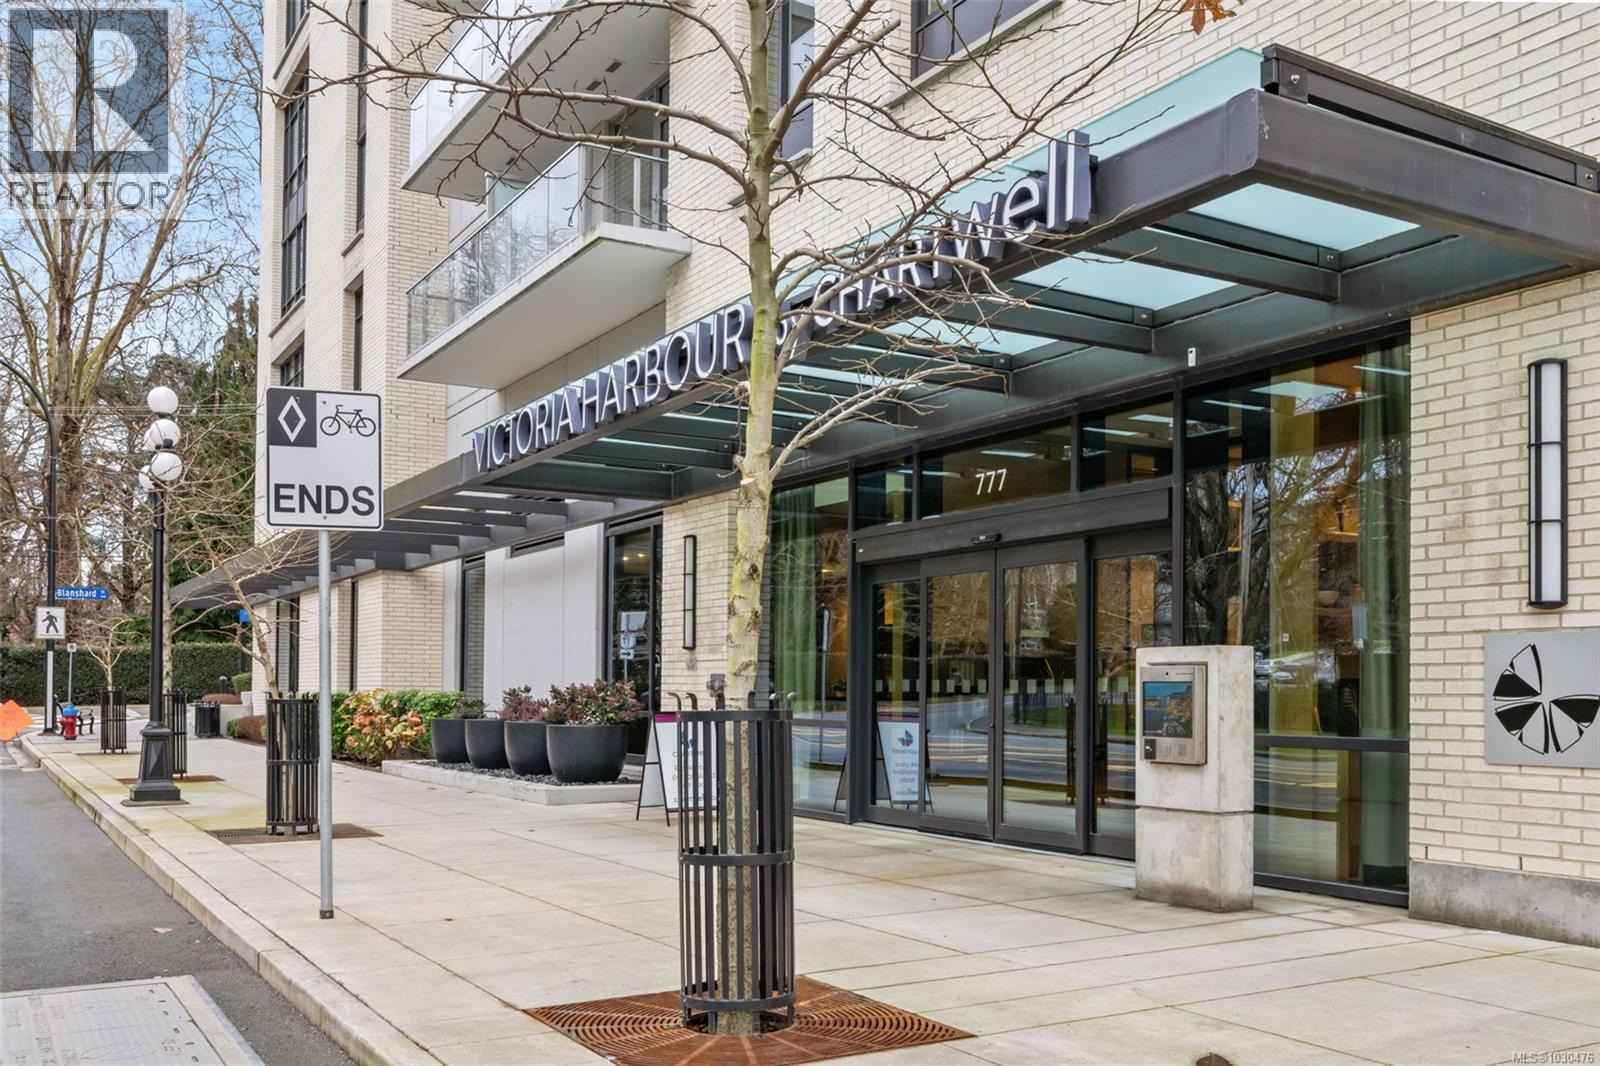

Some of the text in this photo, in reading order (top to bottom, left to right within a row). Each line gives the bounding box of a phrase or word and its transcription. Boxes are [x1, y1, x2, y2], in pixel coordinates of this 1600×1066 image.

[473, 386, 577, 473] VICTORIA
[582, 302, 748, 430] HARBOUR
[975, 467, 1007, 496] 777
[274, 483, 375, 516] ENDS
[57, 588, 97, 598] Blanshard
